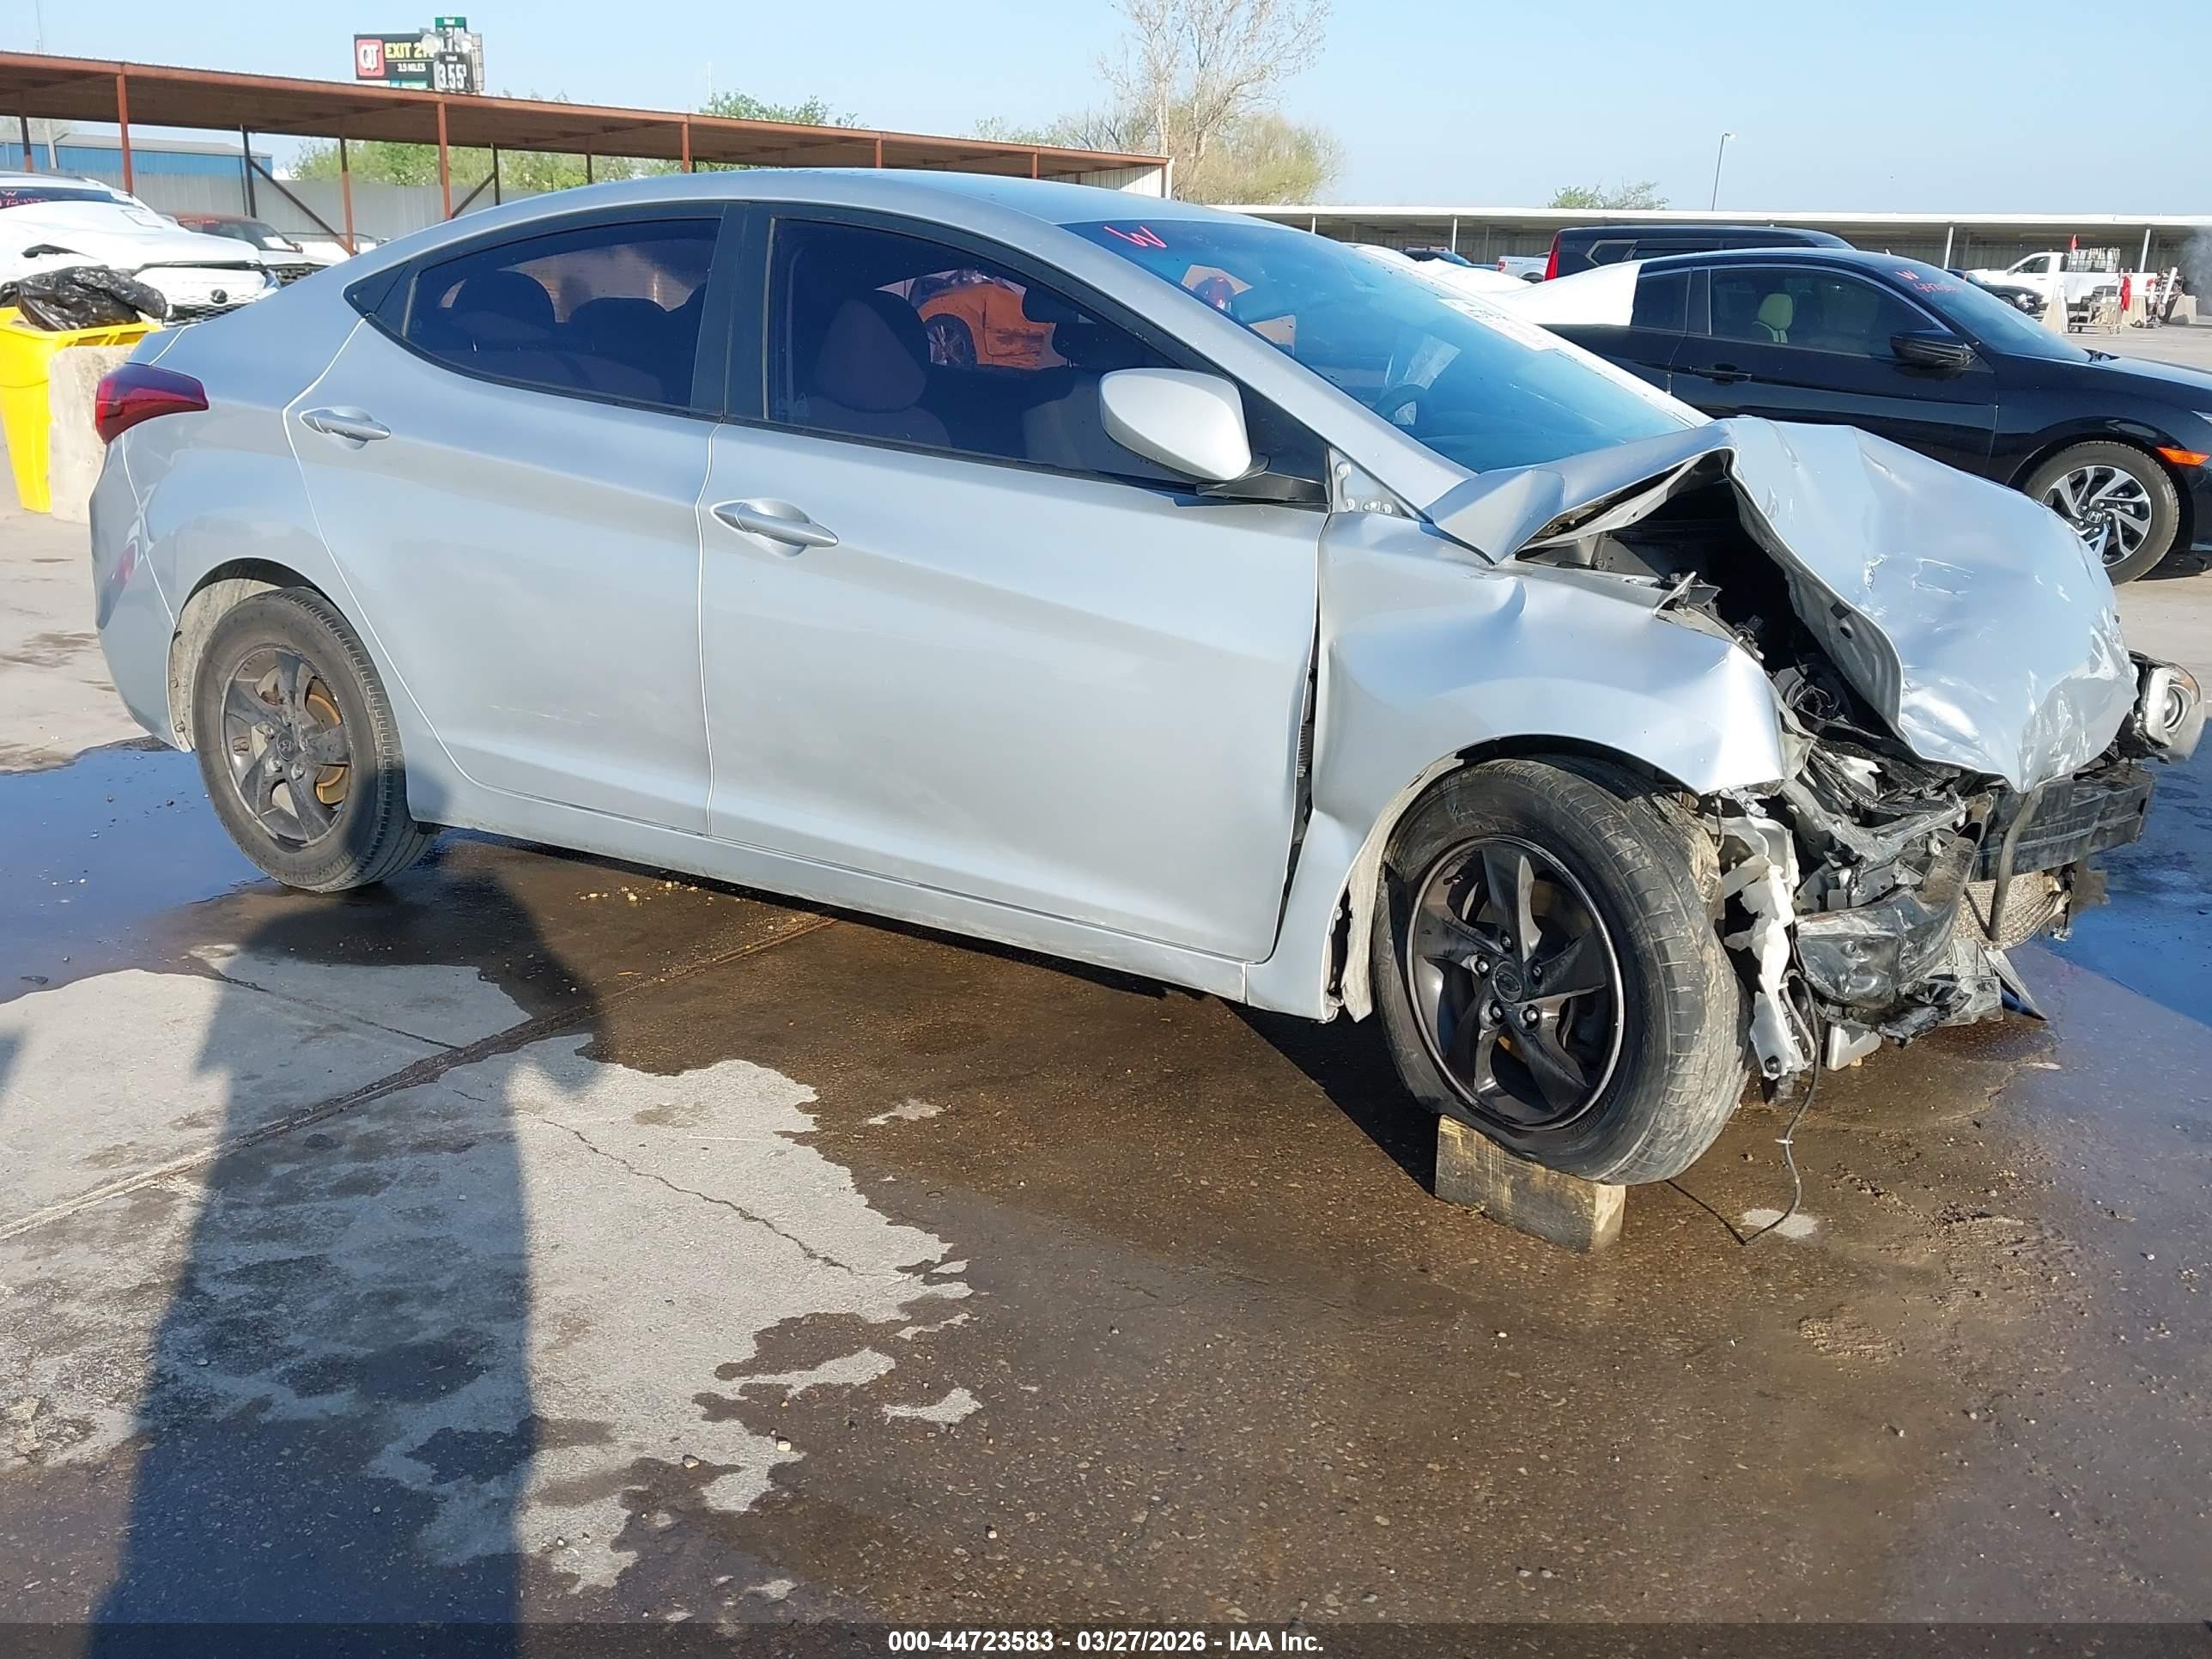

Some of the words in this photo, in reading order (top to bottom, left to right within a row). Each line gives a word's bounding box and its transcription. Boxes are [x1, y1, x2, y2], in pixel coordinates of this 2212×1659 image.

[359, 44, 380, 71] QT
[385, 42, 412, 58] EXIT
[407, 63, 427, 72] MILES
[1103, 225, 1168, 248] W
[1894, 269, 1920, 280] W
